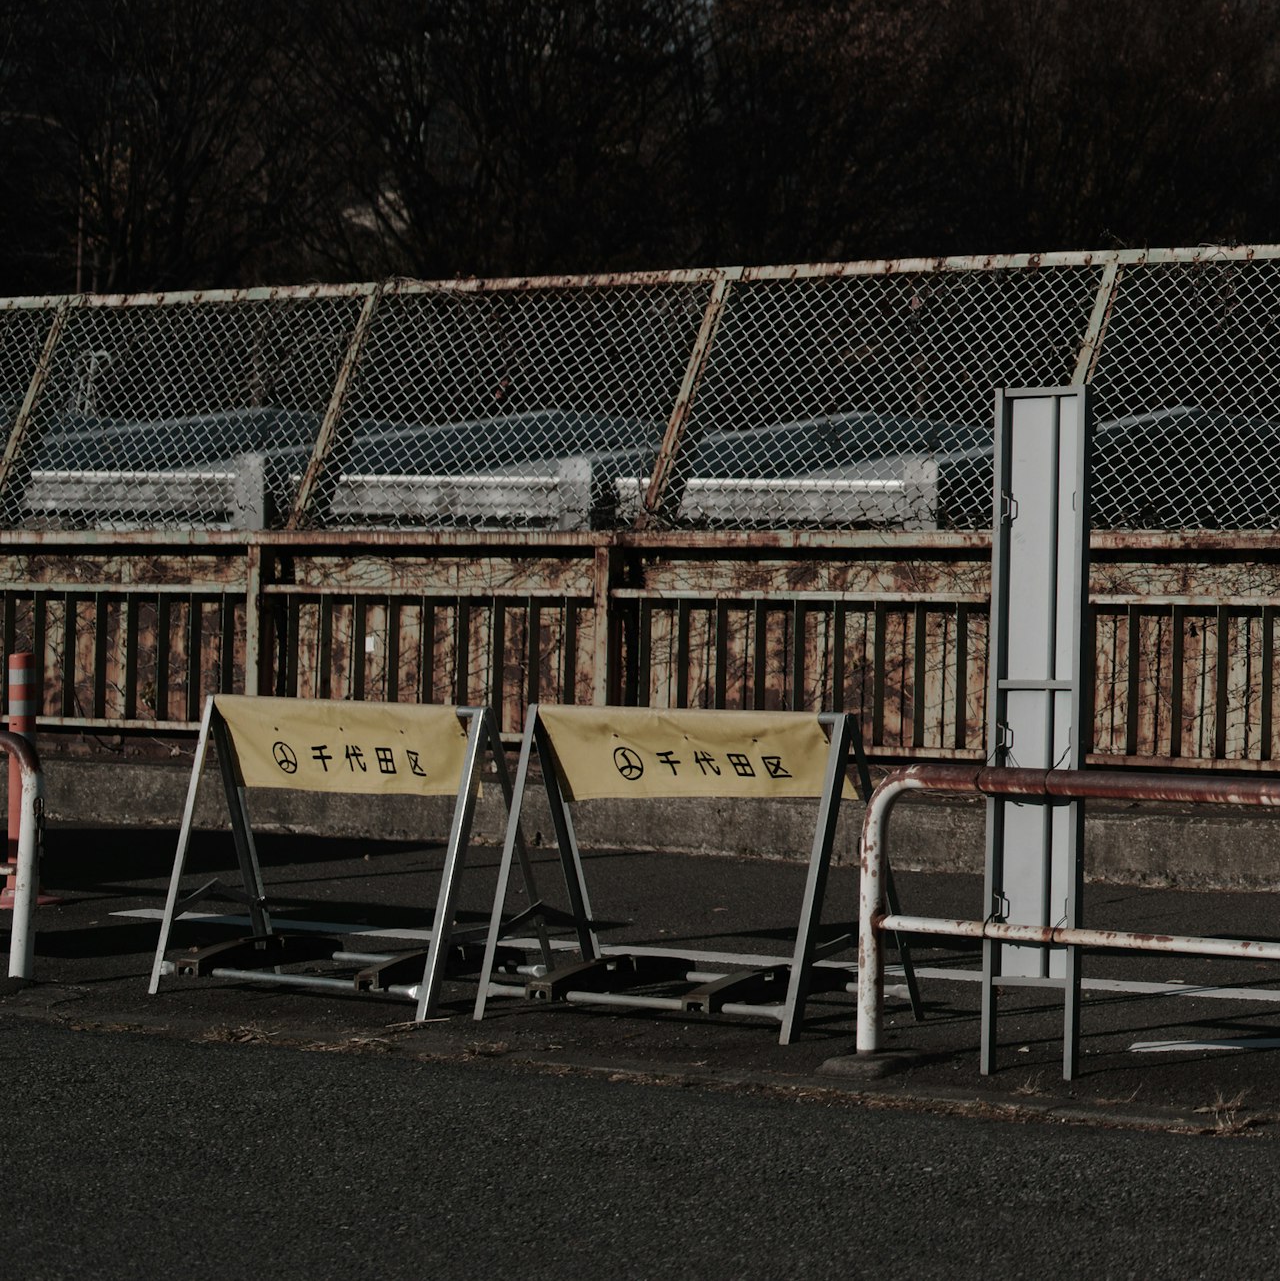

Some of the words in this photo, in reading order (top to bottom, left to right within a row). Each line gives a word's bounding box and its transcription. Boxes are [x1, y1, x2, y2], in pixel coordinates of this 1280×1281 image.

[311, 745, 427, 776] 千代田区
[656, 750, 793, 778] 千代田区
